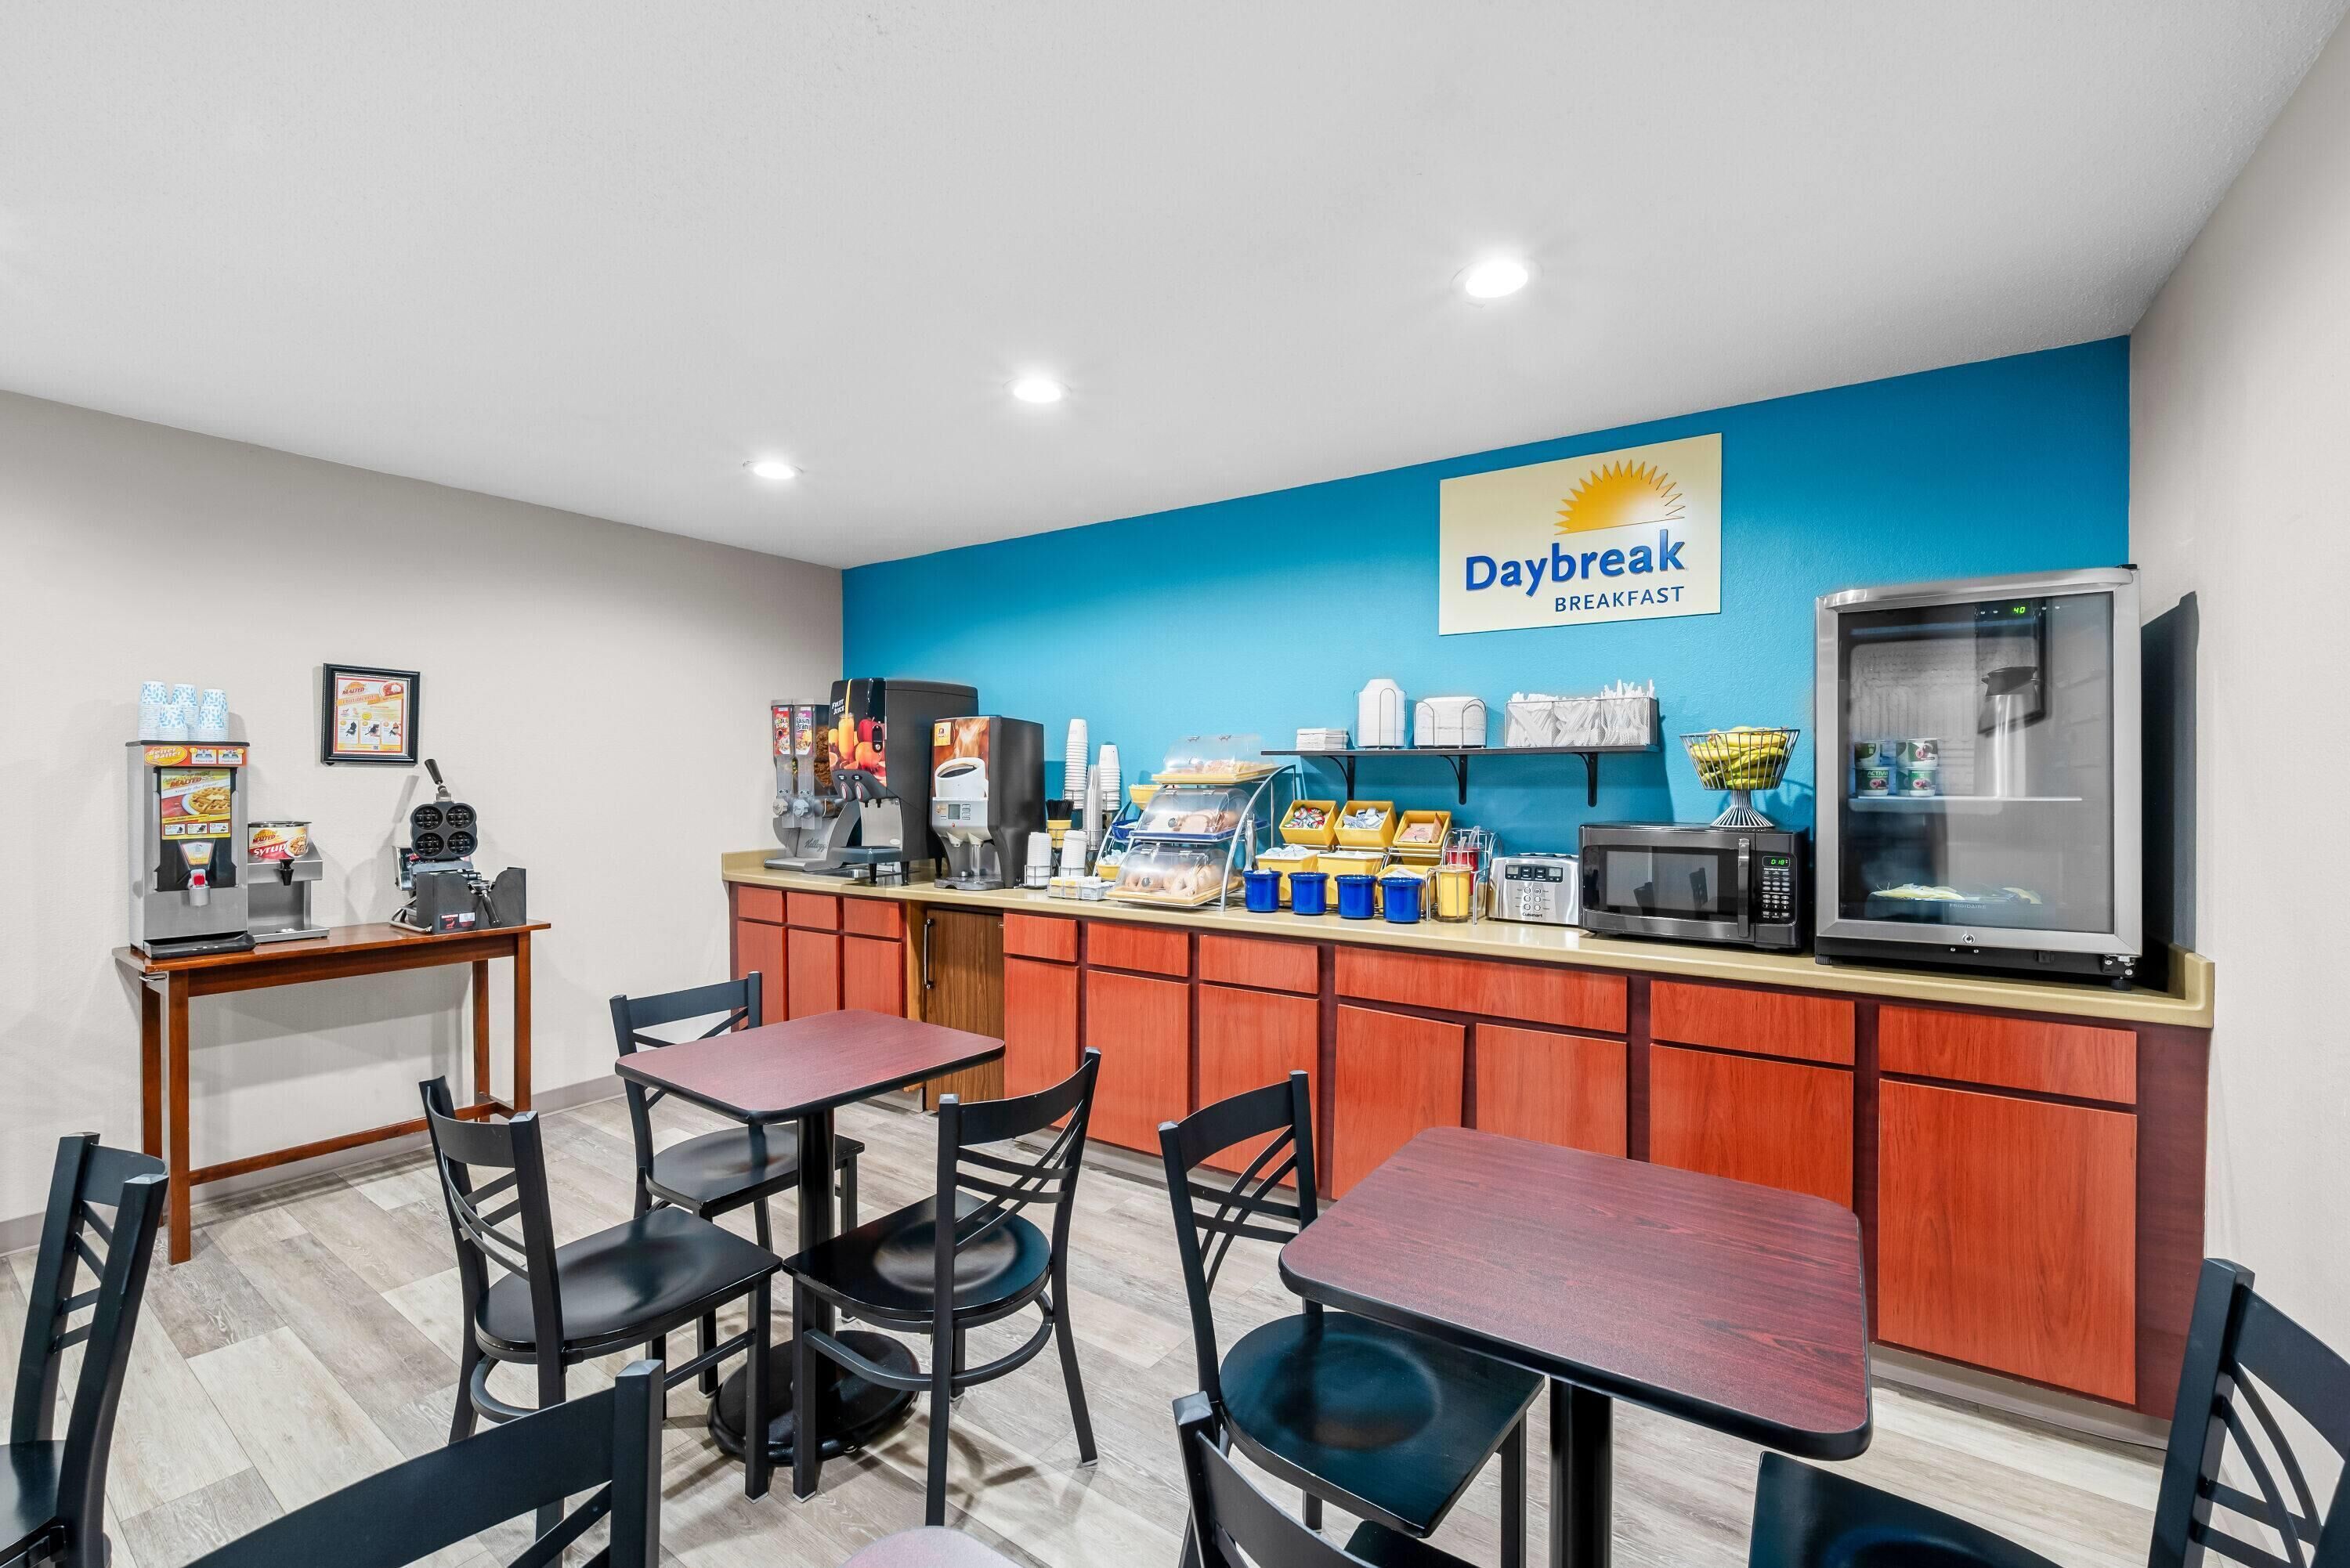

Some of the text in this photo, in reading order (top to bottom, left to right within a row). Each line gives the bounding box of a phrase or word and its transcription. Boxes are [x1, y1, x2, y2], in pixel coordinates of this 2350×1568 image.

[1466, 529, 1686, 598] Daybreak
[1555, 586, 1685, 612] BREAKFAST
[833, 705, 845, 715] JUICE
